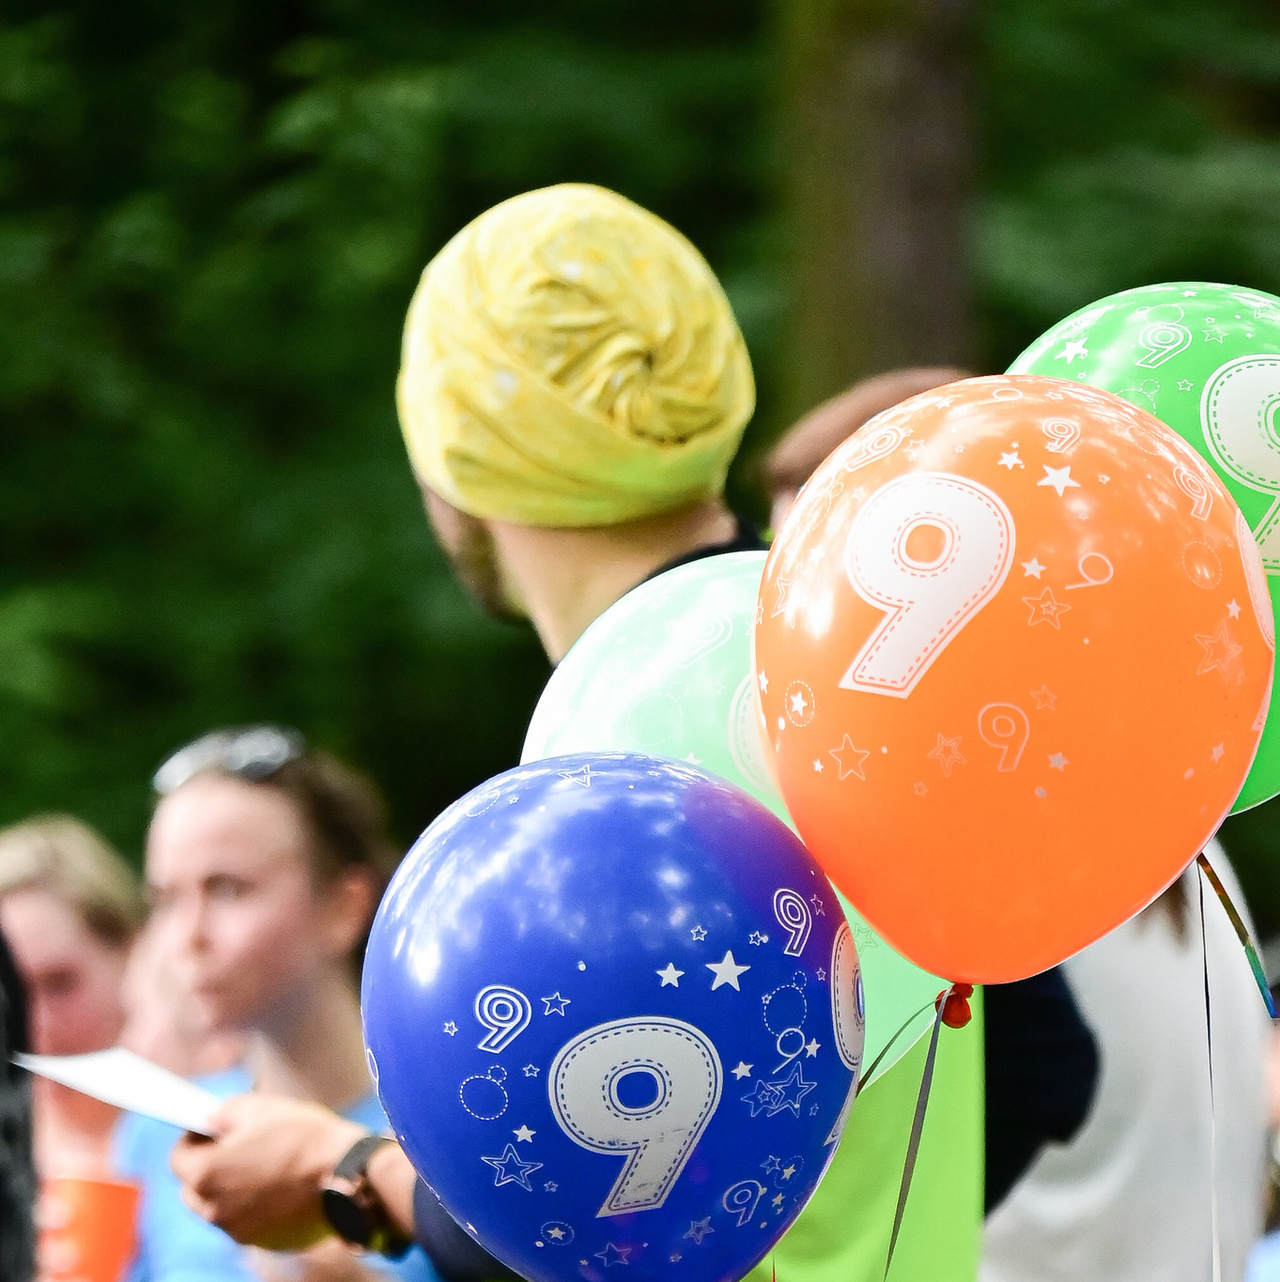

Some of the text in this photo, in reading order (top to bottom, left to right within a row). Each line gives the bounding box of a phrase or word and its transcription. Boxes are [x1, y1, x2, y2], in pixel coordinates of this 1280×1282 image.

[1135, 320, 1193, 369] 9
[1042, 417, 1081, 454] 9
[1172, 465, 1214, 521] 9
[838, 471, 1017, 699] 9
[977, 703, 1030, 772] 9
[773, 888, 812, 957] 9
[473, 985, 532, 1053] 9
[548, 1016, 723, 1218] 9
[722, 1179, 763, 1227] 9
